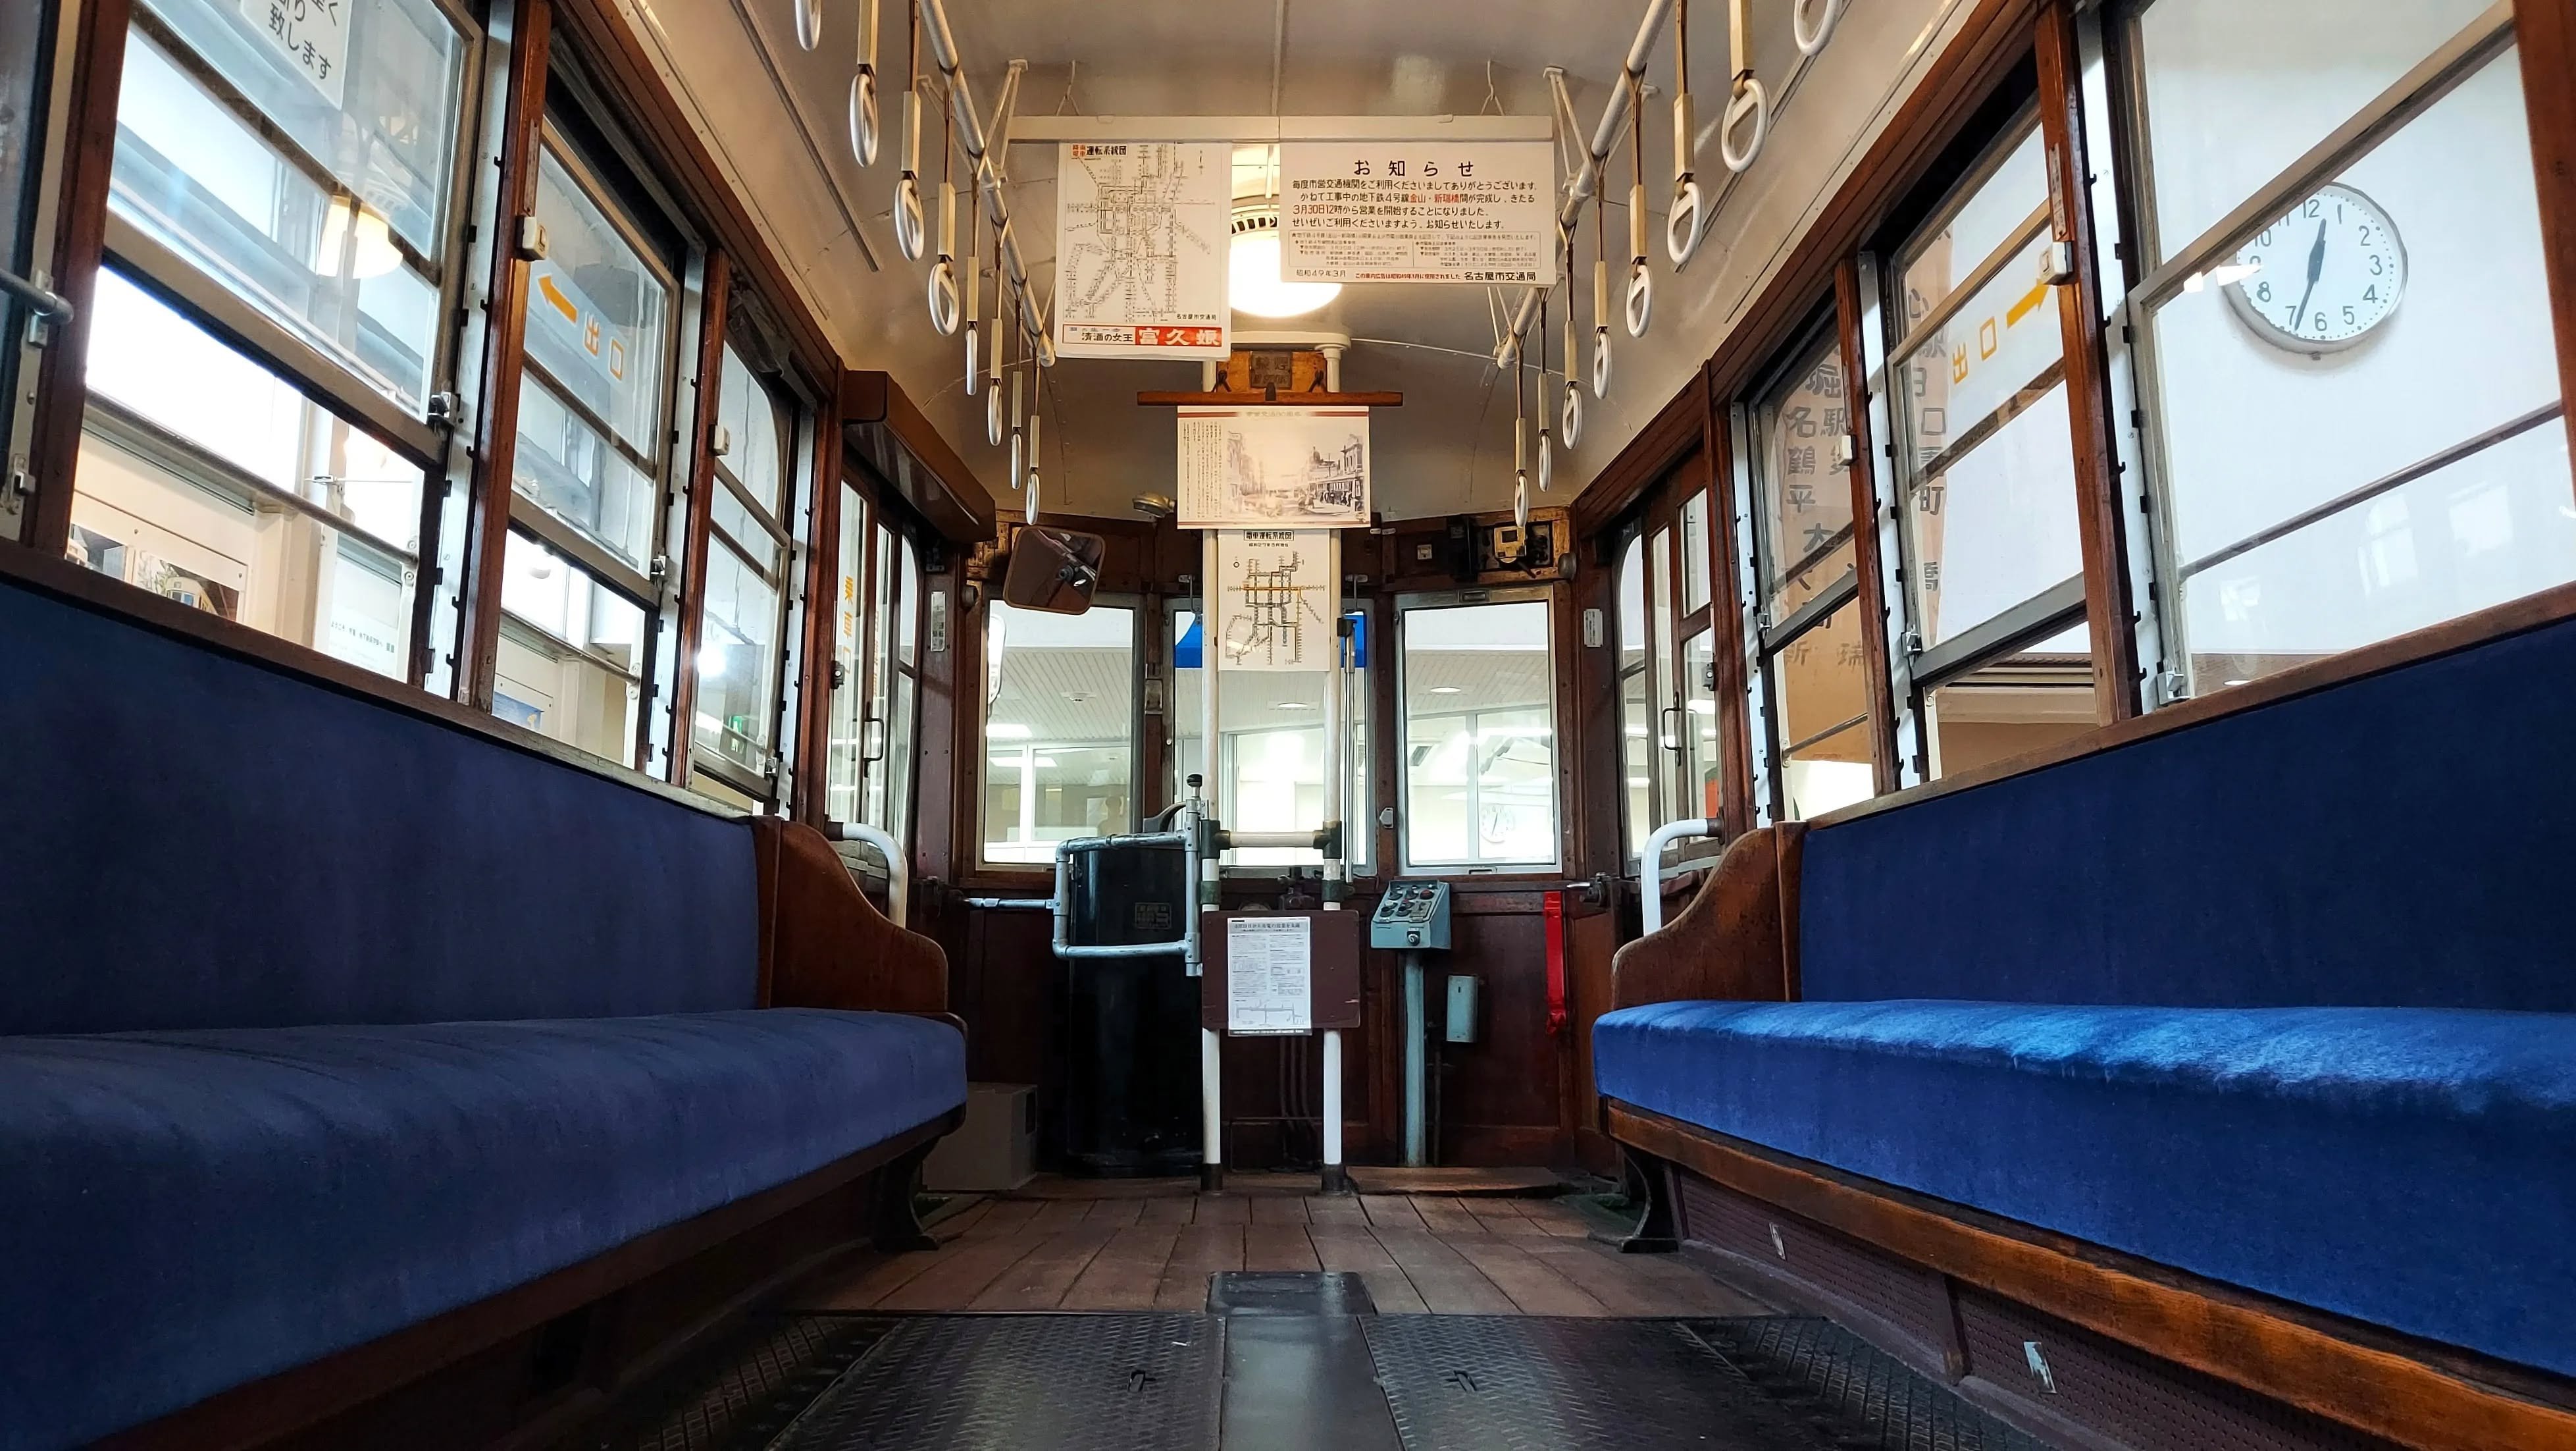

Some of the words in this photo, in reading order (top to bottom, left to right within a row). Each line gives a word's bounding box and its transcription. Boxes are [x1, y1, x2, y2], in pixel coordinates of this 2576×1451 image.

[269, 3, 332, 80] 致します
[1354, 160, 1474, 177] お知らせ
[2303, 199, 2320, 219] 12
[2337, 204, 2342, 224] 1
[2358, 225, 2371, 246] 2
[1296, 269, 1347, 279] 昭和49年3月
[2369, 254, 2383, 275] 3
[1464, 271, 1537, 282] 名古屋市交通局
[2257, 282, 2272, 303] 8
[2362, 284, 2378, 303] 4
[2285, 306, 2297, 325] 7
[2315, 312, 2327, 331] 6
[2342, 306, 2355, 325] 5
[1081, 332, 1133, 342] 清酒の女王
[1139, 327, 1221, 346] 富久娘
[584, 312, 625, 381] 出口
[1953, 317, 1997, 384] 出口
